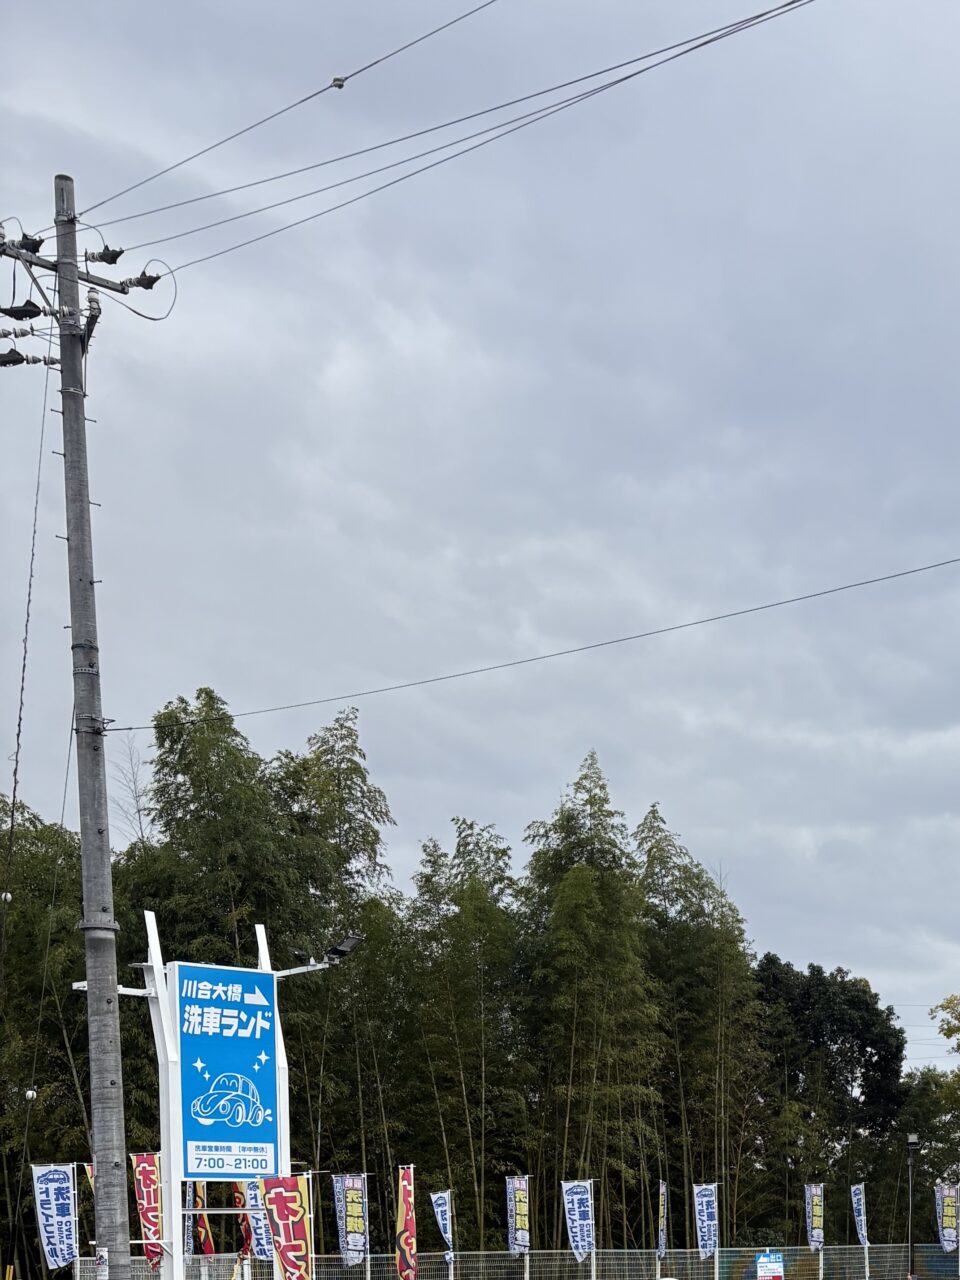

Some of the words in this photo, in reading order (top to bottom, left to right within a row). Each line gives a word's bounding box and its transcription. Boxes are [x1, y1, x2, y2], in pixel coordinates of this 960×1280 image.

[181, 979, 243, 1002] 川合大橋
[182, 1004, 273, 1039] 洗車ランド
